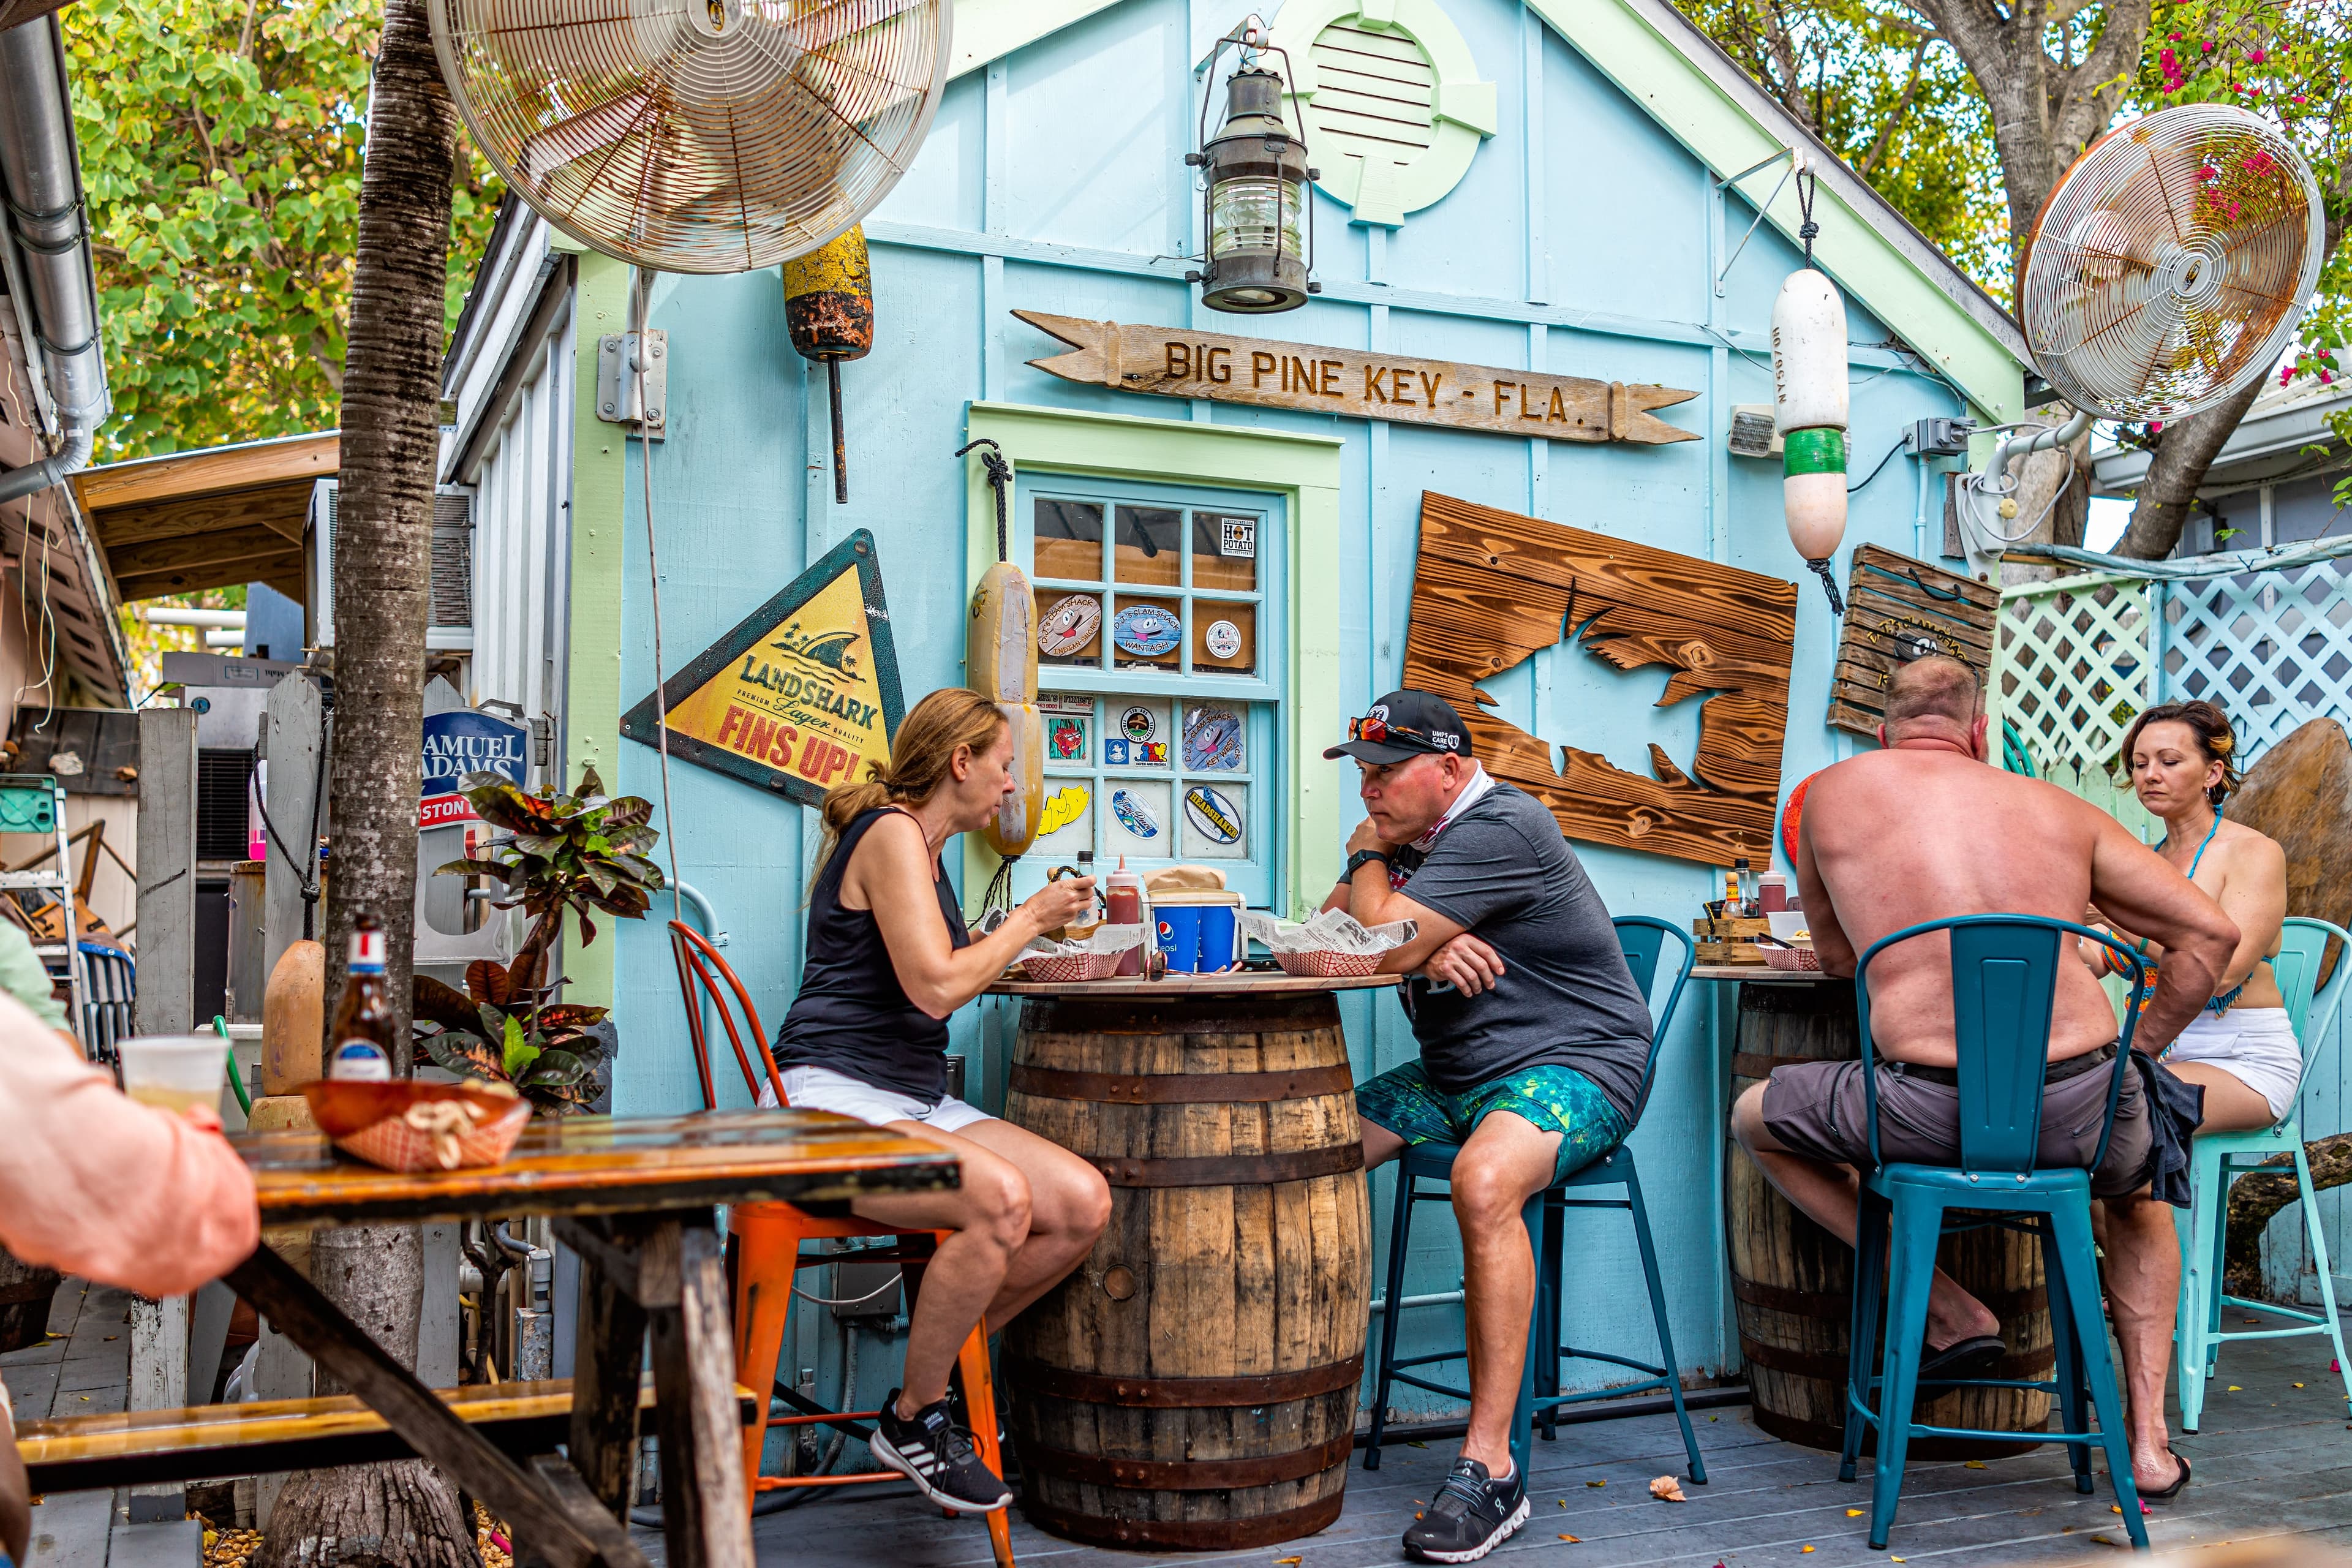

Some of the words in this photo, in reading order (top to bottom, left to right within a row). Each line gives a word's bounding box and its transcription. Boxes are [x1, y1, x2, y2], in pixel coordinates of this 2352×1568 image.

[1165, 341, 1231, 384] BIG
[1251, 351, 1344, 398] PINE
[1364, 364, 1442, 410] KEY
[1493, 379, 1584, 426] FLA.
[1223, 539, 1253, 550] POTATO
[1048, 603, 1066, 621] CLAM
[1066, 599, 1093, 608] SHACK
[1156, 611, 1180, 631] SHACK
[1054, 641, 1082, 654] INDIAN
[1081, 615, 1099, 643] SHORES
[1125, 640, 1169, 652] WANTAGH
[1936, 629, 1968, 661] SHAC
[740, 654, 878, 730] LANDSHARK
[1063, 695, 1093, 704] FINEST
[737, 688, 770, 706] PREMIUM
[773, 697, 832, 729] Lager
[833, 727, 864, 744] QUALITY
[1190, 720, 1205, 739] CLAM
[1206, 713, 1232, 723] SHACK
[421, 734, 523, 762] AMUEL
[716, 704, 798, 767] FINS
[798, 735, 861, 786] UP!
[1205, 753, 1219, 767] KEY
[1219, 736, 1235, 758] WEST
[421, 801, 464, 820] STON
[1189, 791, 1238, 839] HEADSHAKER
[1159, 944, 1177, 953] pepsi
